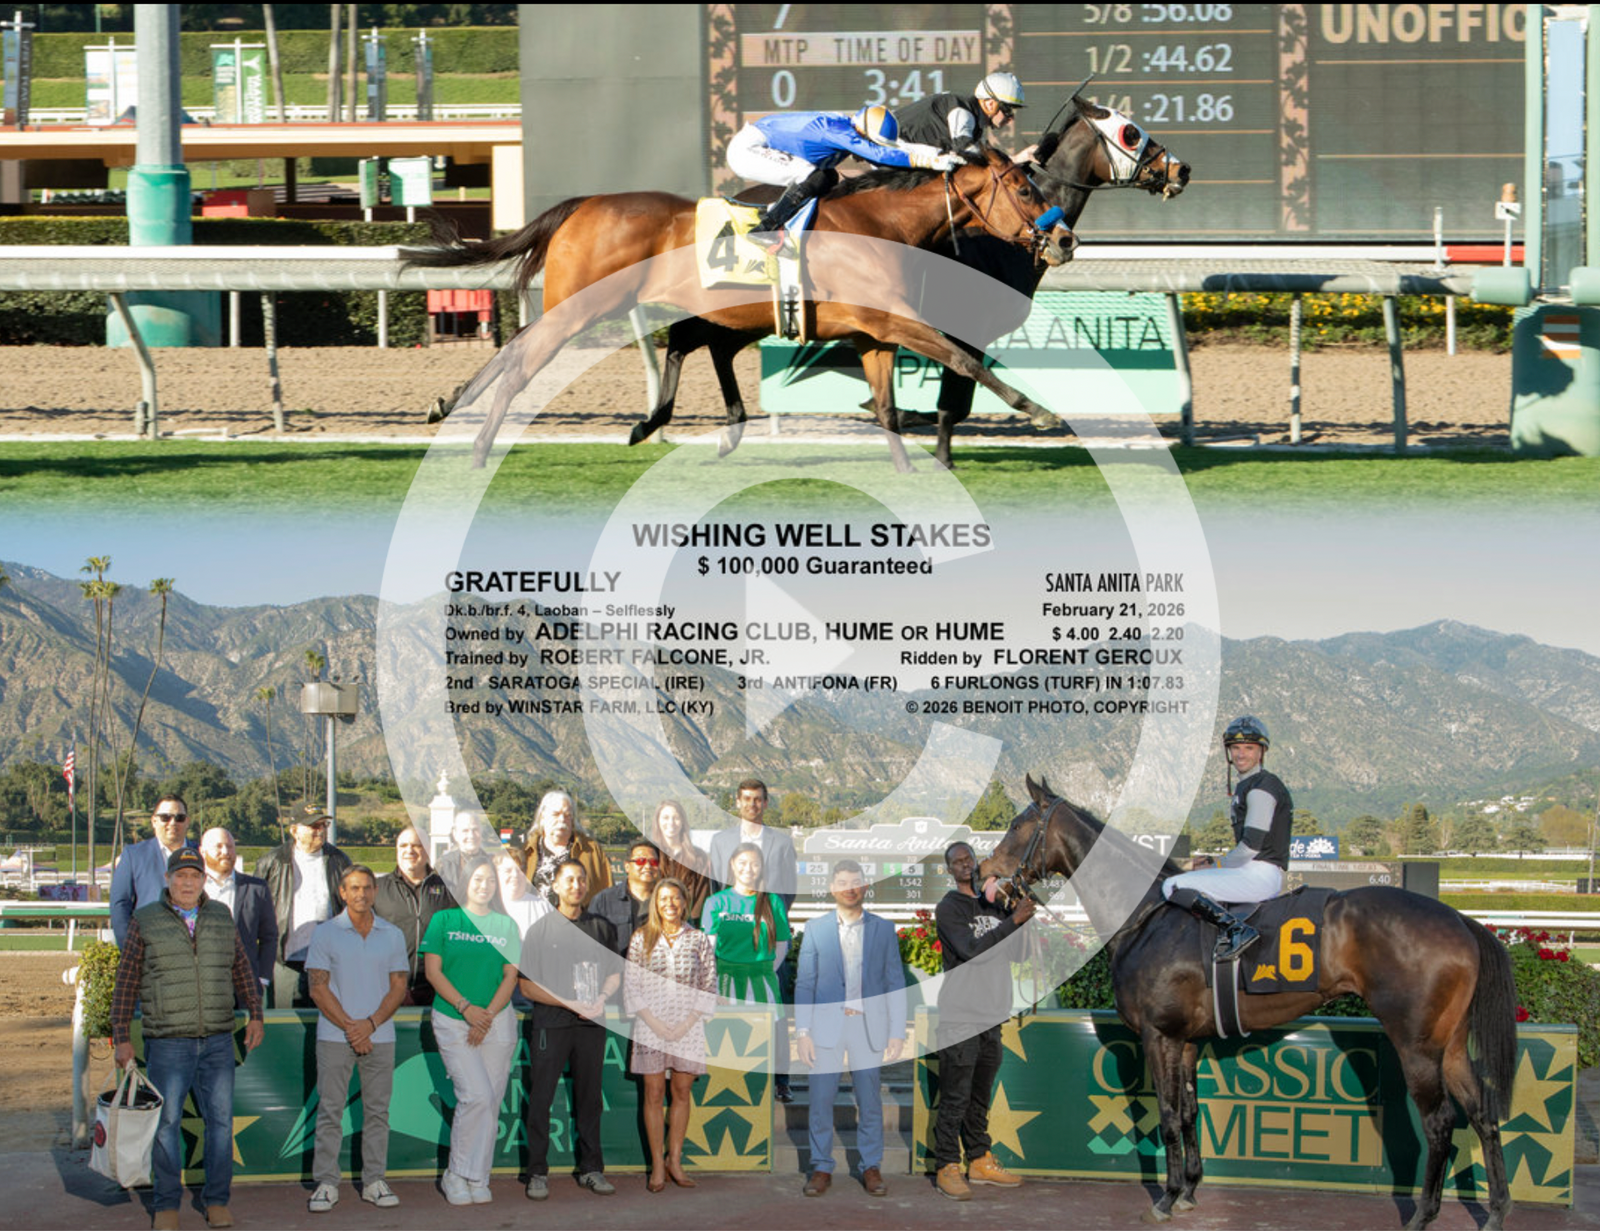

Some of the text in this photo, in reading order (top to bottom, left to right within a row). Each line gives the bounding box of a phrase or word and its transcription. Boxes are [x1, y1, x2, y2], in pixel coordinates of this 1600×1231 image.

[764, 36, 976, 63] MTP TIME OF DAY
[1085, 43, 1233, 74] 1/2 :44.62
[771, 70, 797, 108] 0
[1143, 93, 1234, 122] :21.86
[707, 220, 739, 272] 4
[1044, 316, 1166, 350] ANITA
[824, 834, 893, 850] Santa
[1369, 875, 1391, 885] 6.40
[447, 931, 508, 947] TSINGTAO
[1279, 917, 1316, 982] 6
[1200, 1103, 1378, 1162] MEET
